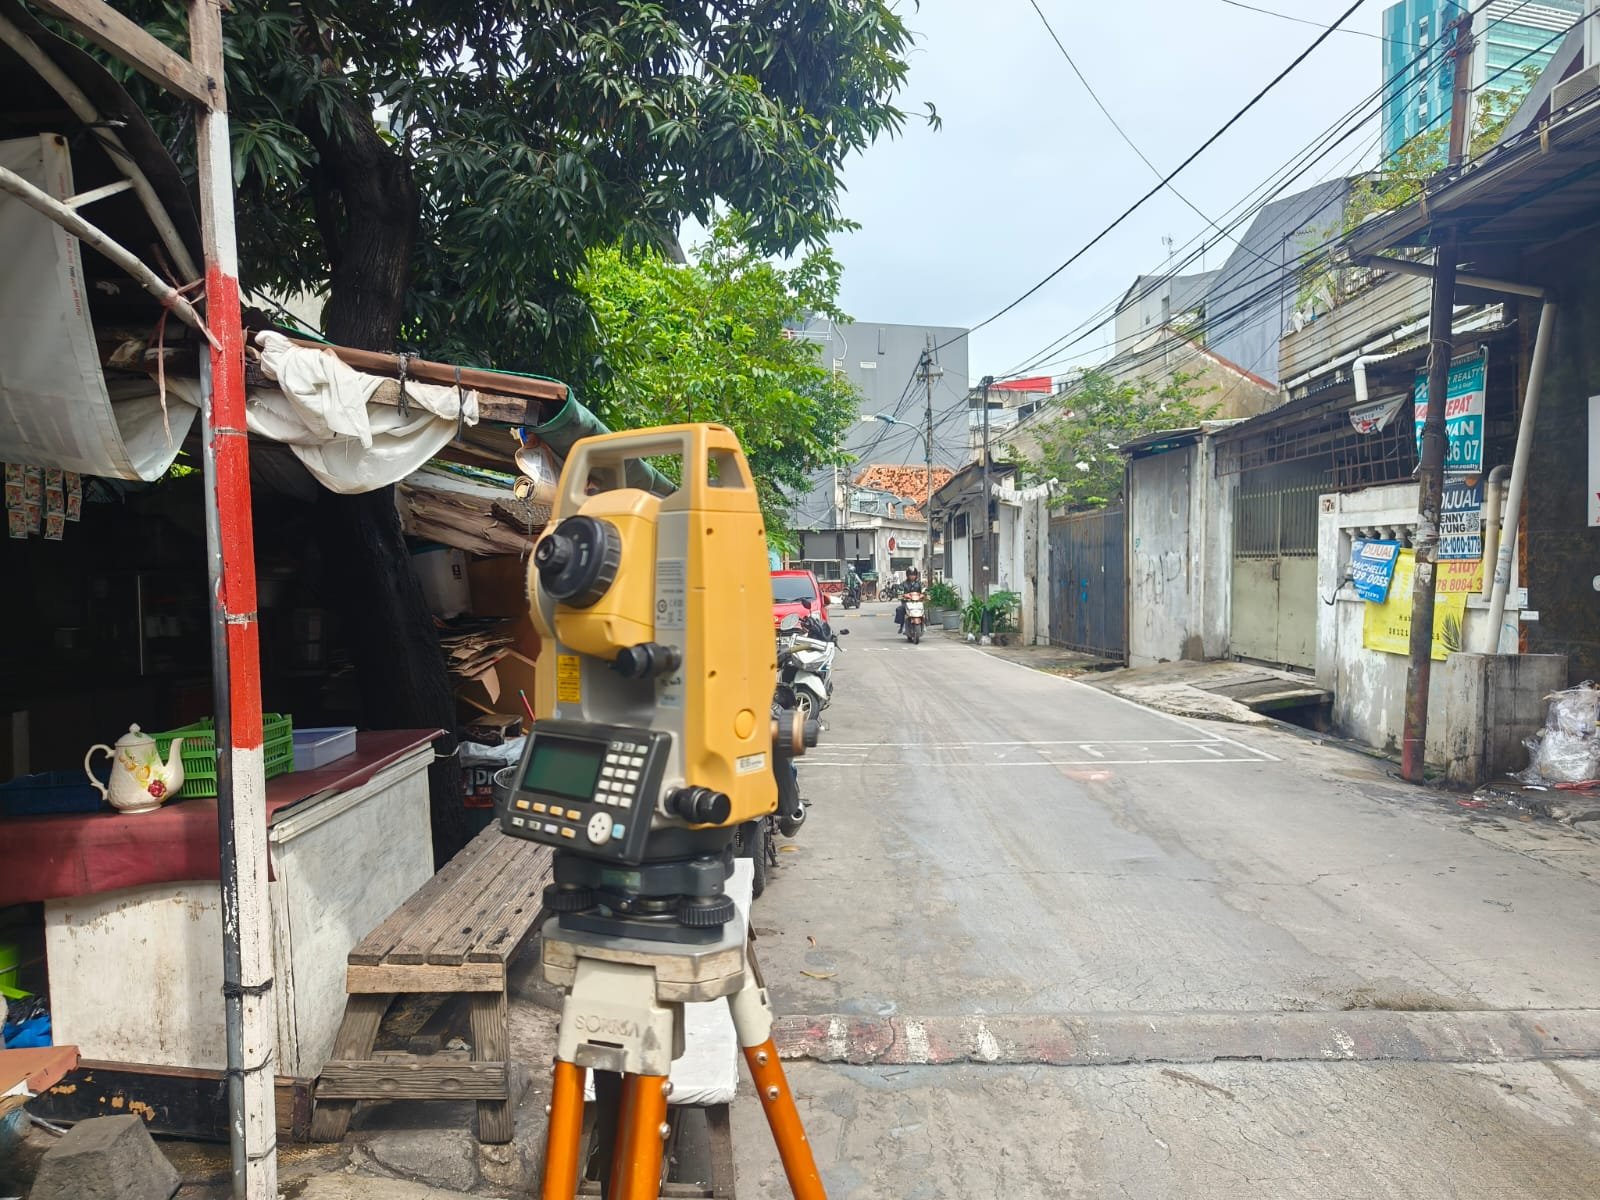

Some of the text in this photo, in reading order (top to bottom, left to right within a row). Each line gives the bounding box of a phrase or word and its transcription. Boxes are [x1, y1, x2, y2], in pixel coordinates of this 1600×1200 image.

[1446, 394, 1473, 418] EPAT
[1444, 420, 1474, 437] WAN
[1464, 439, 1480, 461] 07
[1440, 512, 1465, 524] ENNY
[1437, 579, 1448, 592] 78
[1450, 579, 1472, 591] 8084
